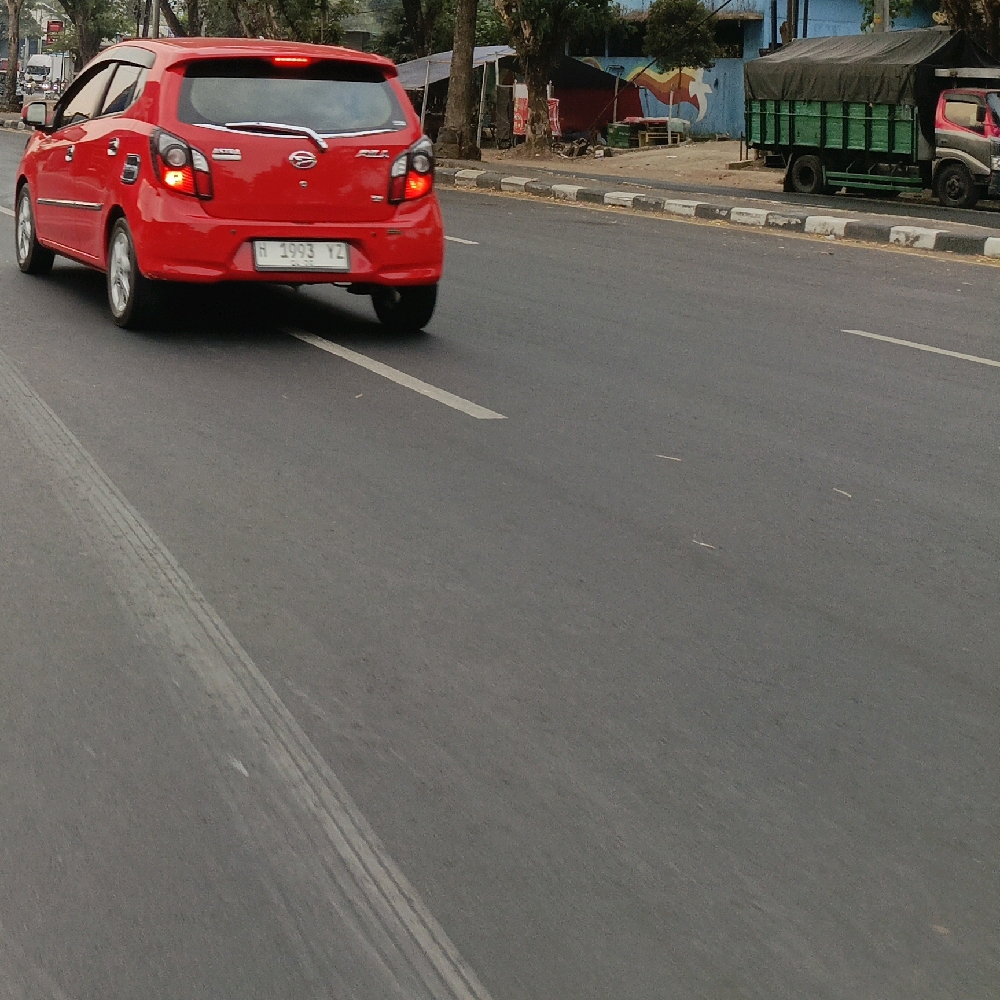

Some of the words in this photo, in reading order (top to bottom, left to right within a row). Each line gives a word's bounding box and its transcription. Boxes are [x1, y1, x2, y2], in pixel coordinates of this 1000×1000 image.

[258, 242, 268, 258] H
[279, 243, 315, 259] 1993
[326, 244, 345, 260] YZ
